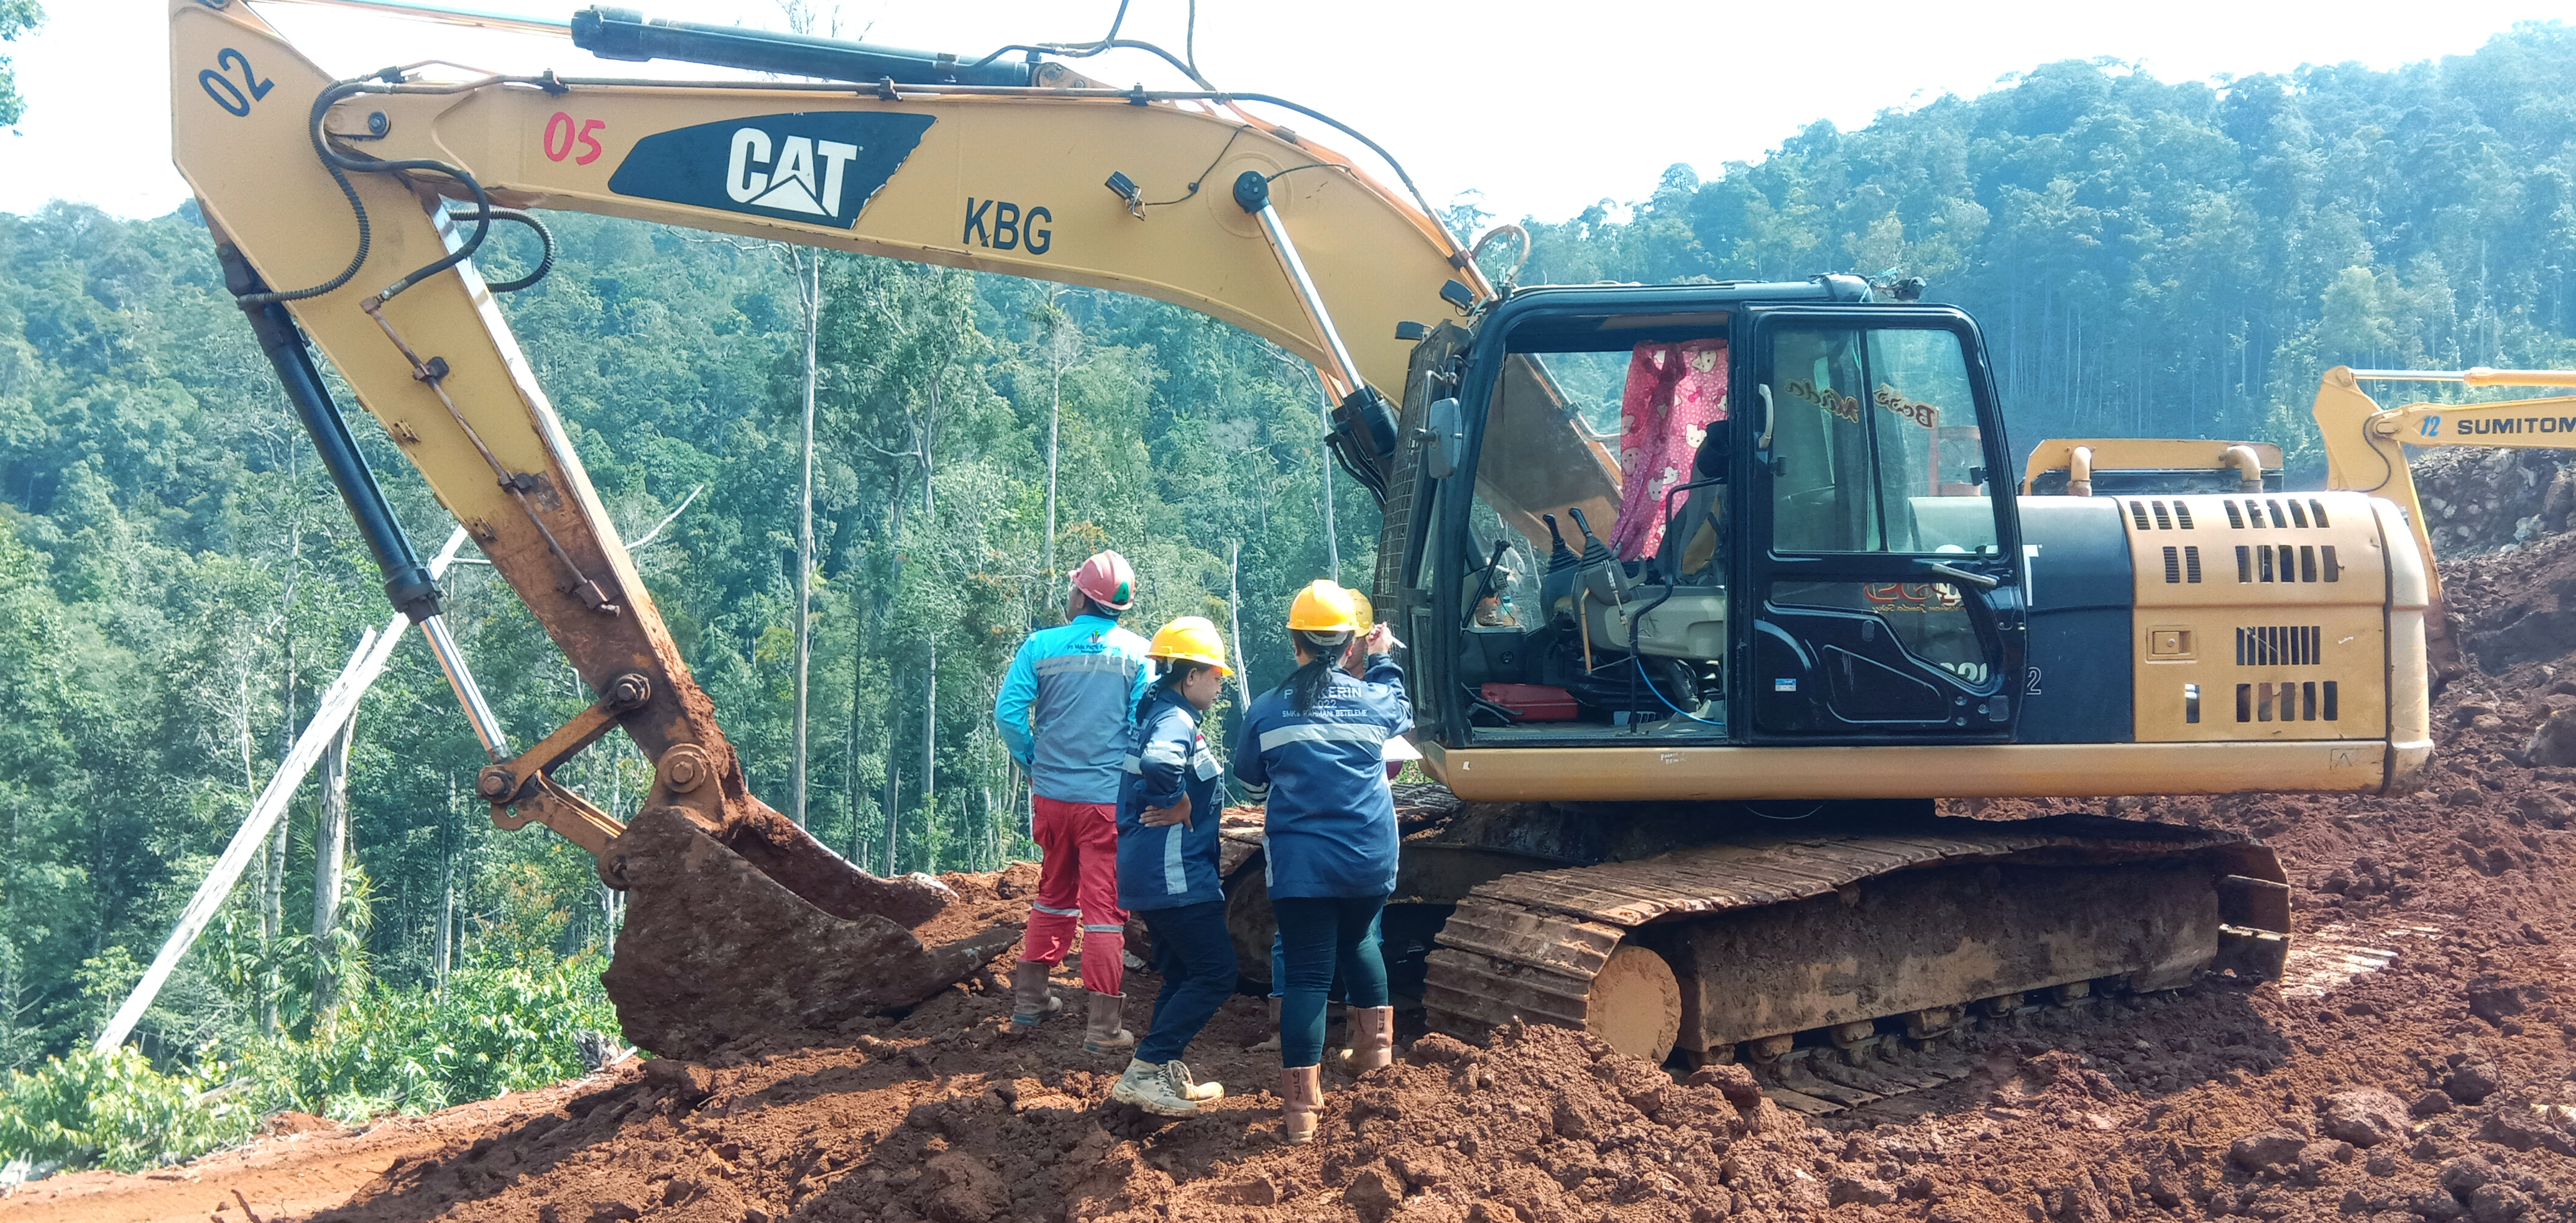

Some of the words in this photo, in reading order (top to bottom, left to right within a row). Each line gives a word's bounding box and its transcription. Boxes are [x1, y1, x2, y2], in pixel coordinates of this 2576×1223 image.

[198, 47, 275, 117] 02
[544, 111, 605, 165] 05
[725, 127, 858, 218] CAT
[964, 196, 1052, 255] KBG
[2420, 415, 2441, 437] 12
[2457, 417, 2576, 434] SUMITOM
[1312, 699, 1338, 708] 022
[1335, 709, 1368, 717] BETELEME
